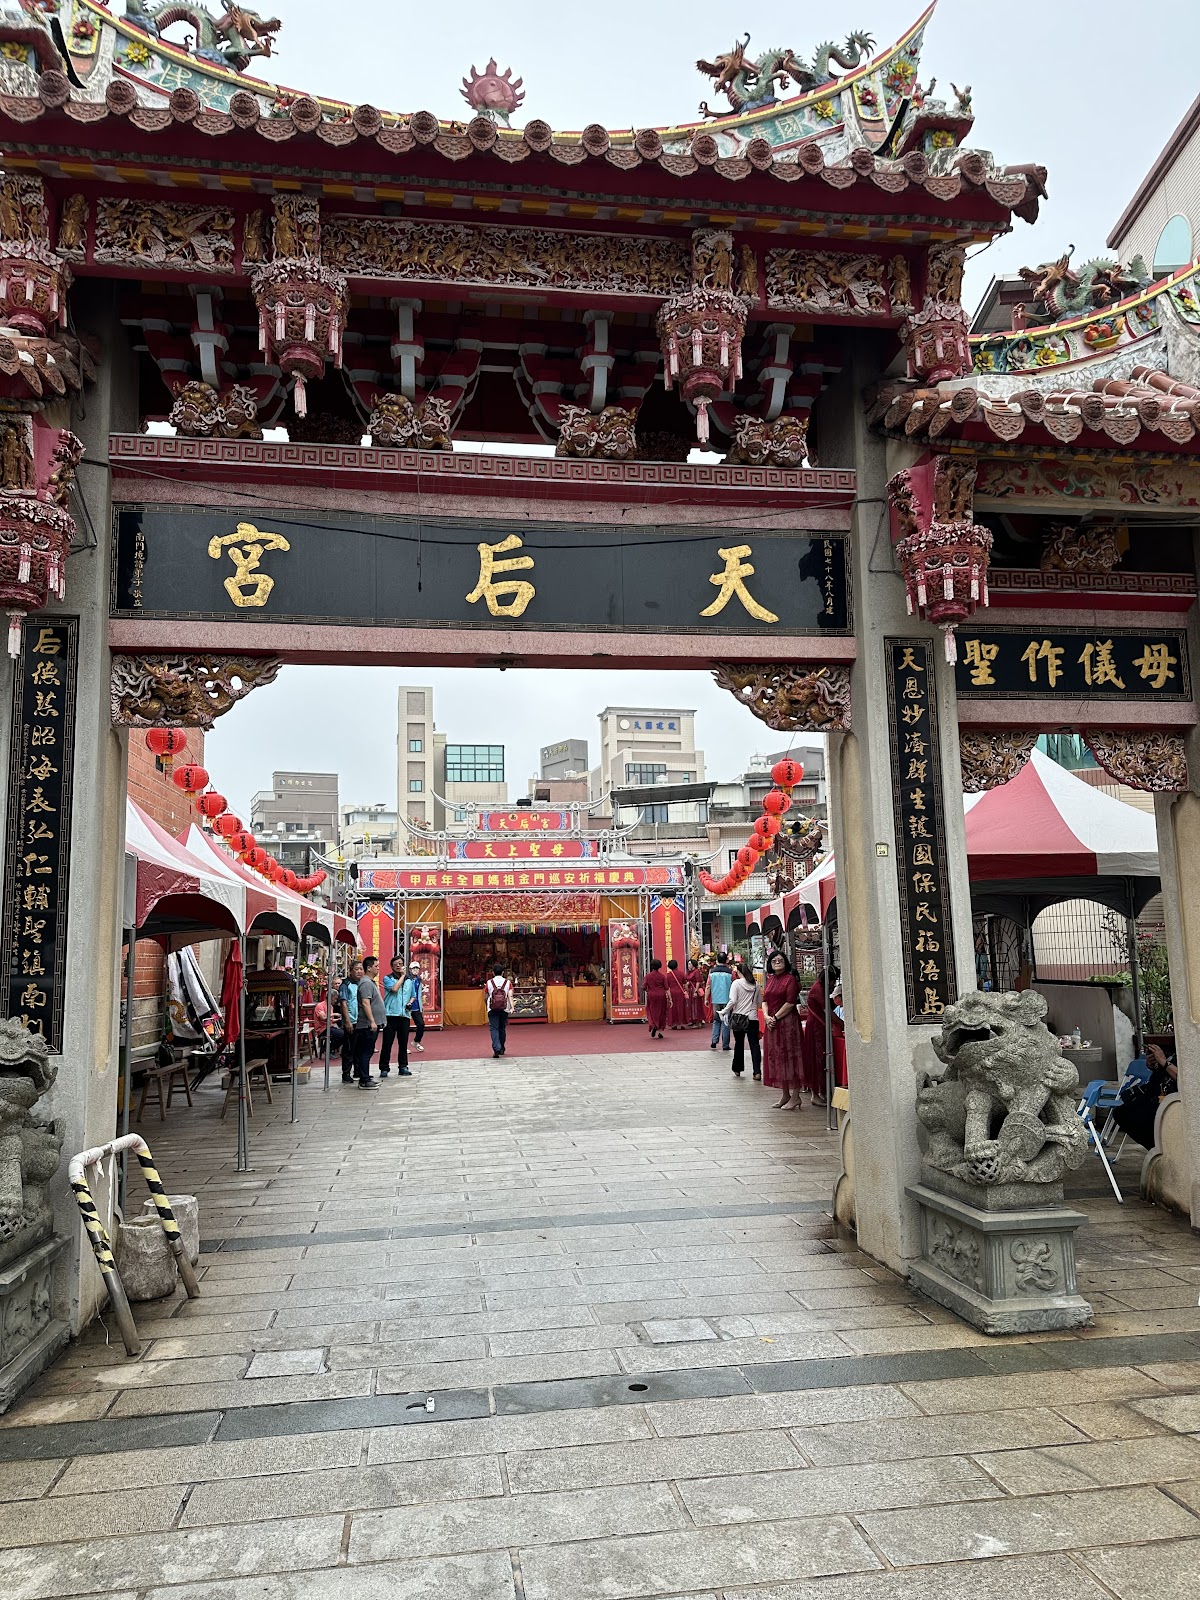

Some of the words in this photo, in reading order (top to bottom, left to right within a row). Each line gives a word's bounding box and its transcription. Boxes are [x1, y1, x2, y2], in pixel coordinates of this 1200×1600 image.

[208, 522, 780, 624] 天后宮
[963, 639, 1178, 690] 母儀作聖
[499, 818, 551, 829] 天后宮
[484, 842, 565, 858] 天上聖母
[410, 871, 635, 887] 甲辰年全國媽祖金門巡安祈福慶典
